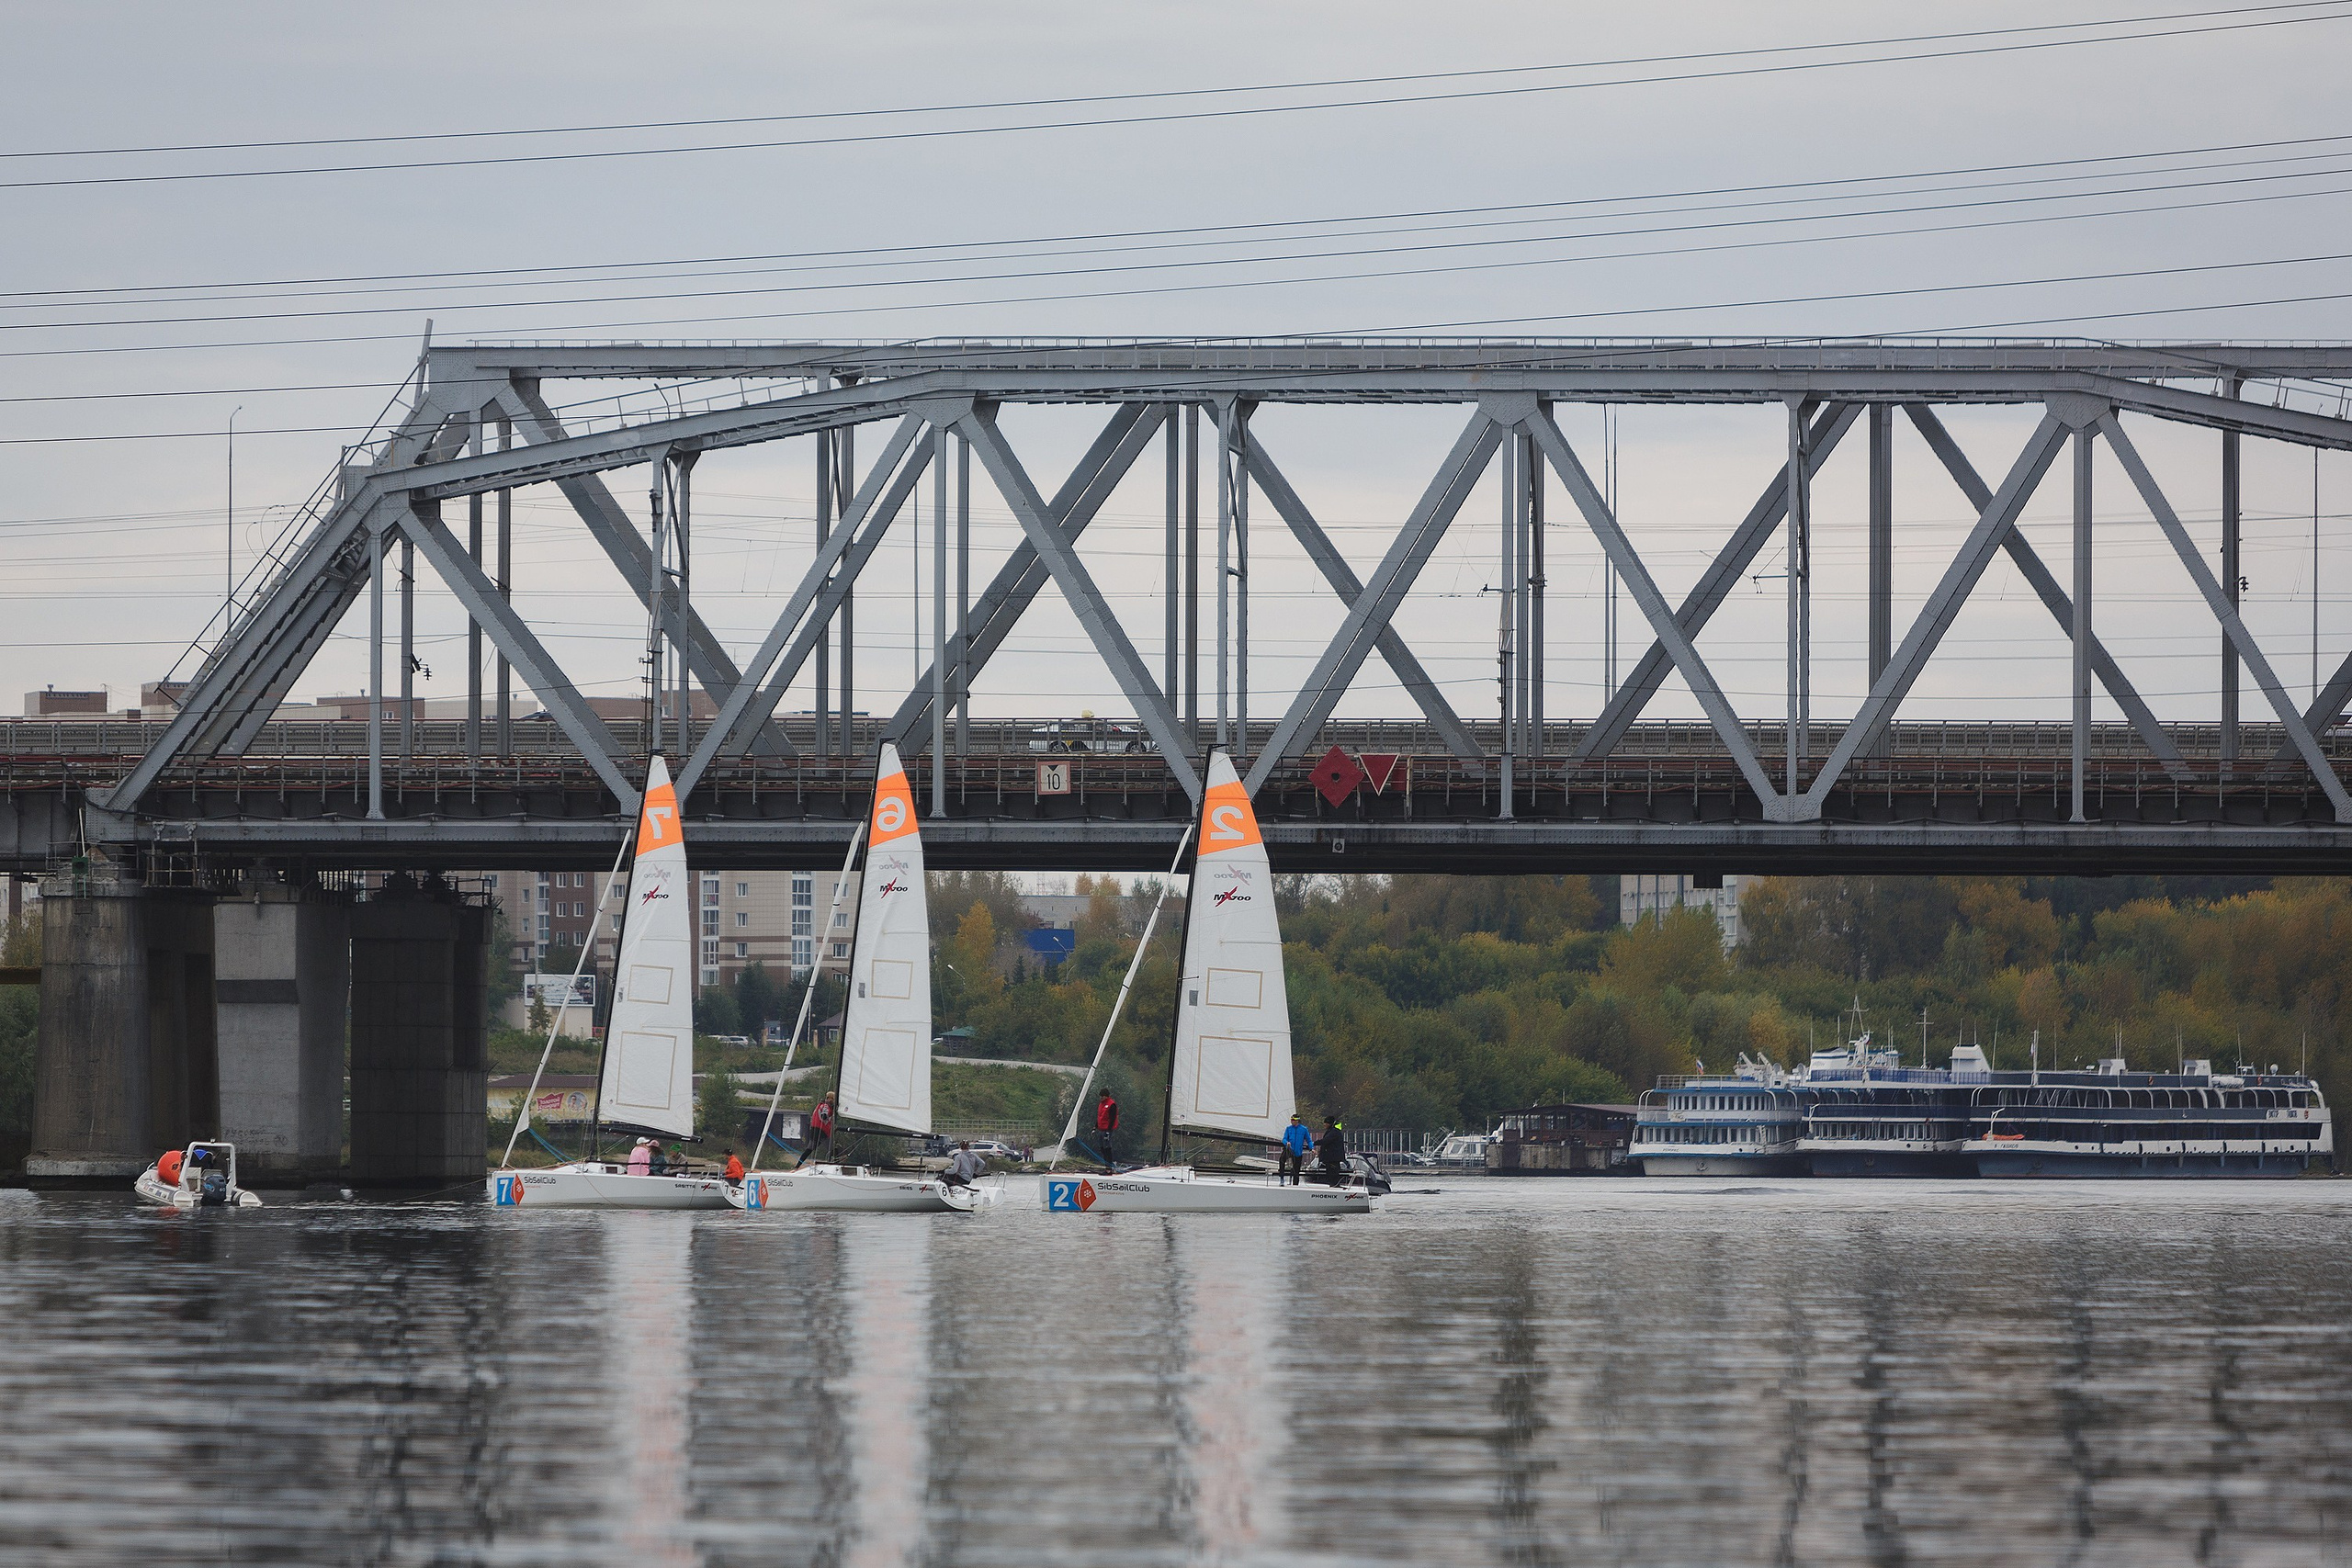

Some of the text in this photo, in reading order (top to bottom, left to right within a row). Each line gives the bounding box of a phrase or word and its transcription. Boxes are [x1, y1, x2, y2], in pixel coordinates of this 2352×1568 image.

[1046, 773, 1060, 790] 10
[1213, 886, 1251, 907] MX700
[524, 1176, 556, 1184] SibSailClub
[767, 1179, 793, 1187] SibSailClub
[500, 1179, 509, 1202] 7
[725, 1184, 729, 1194] 7
[749, 1181, 756, 1205] 6
[942, 1186, 947, 1196] 6
[1097, 1182, 1150, 1192] SibSailClub
[1053, 1183, 1069, 1207] 2
